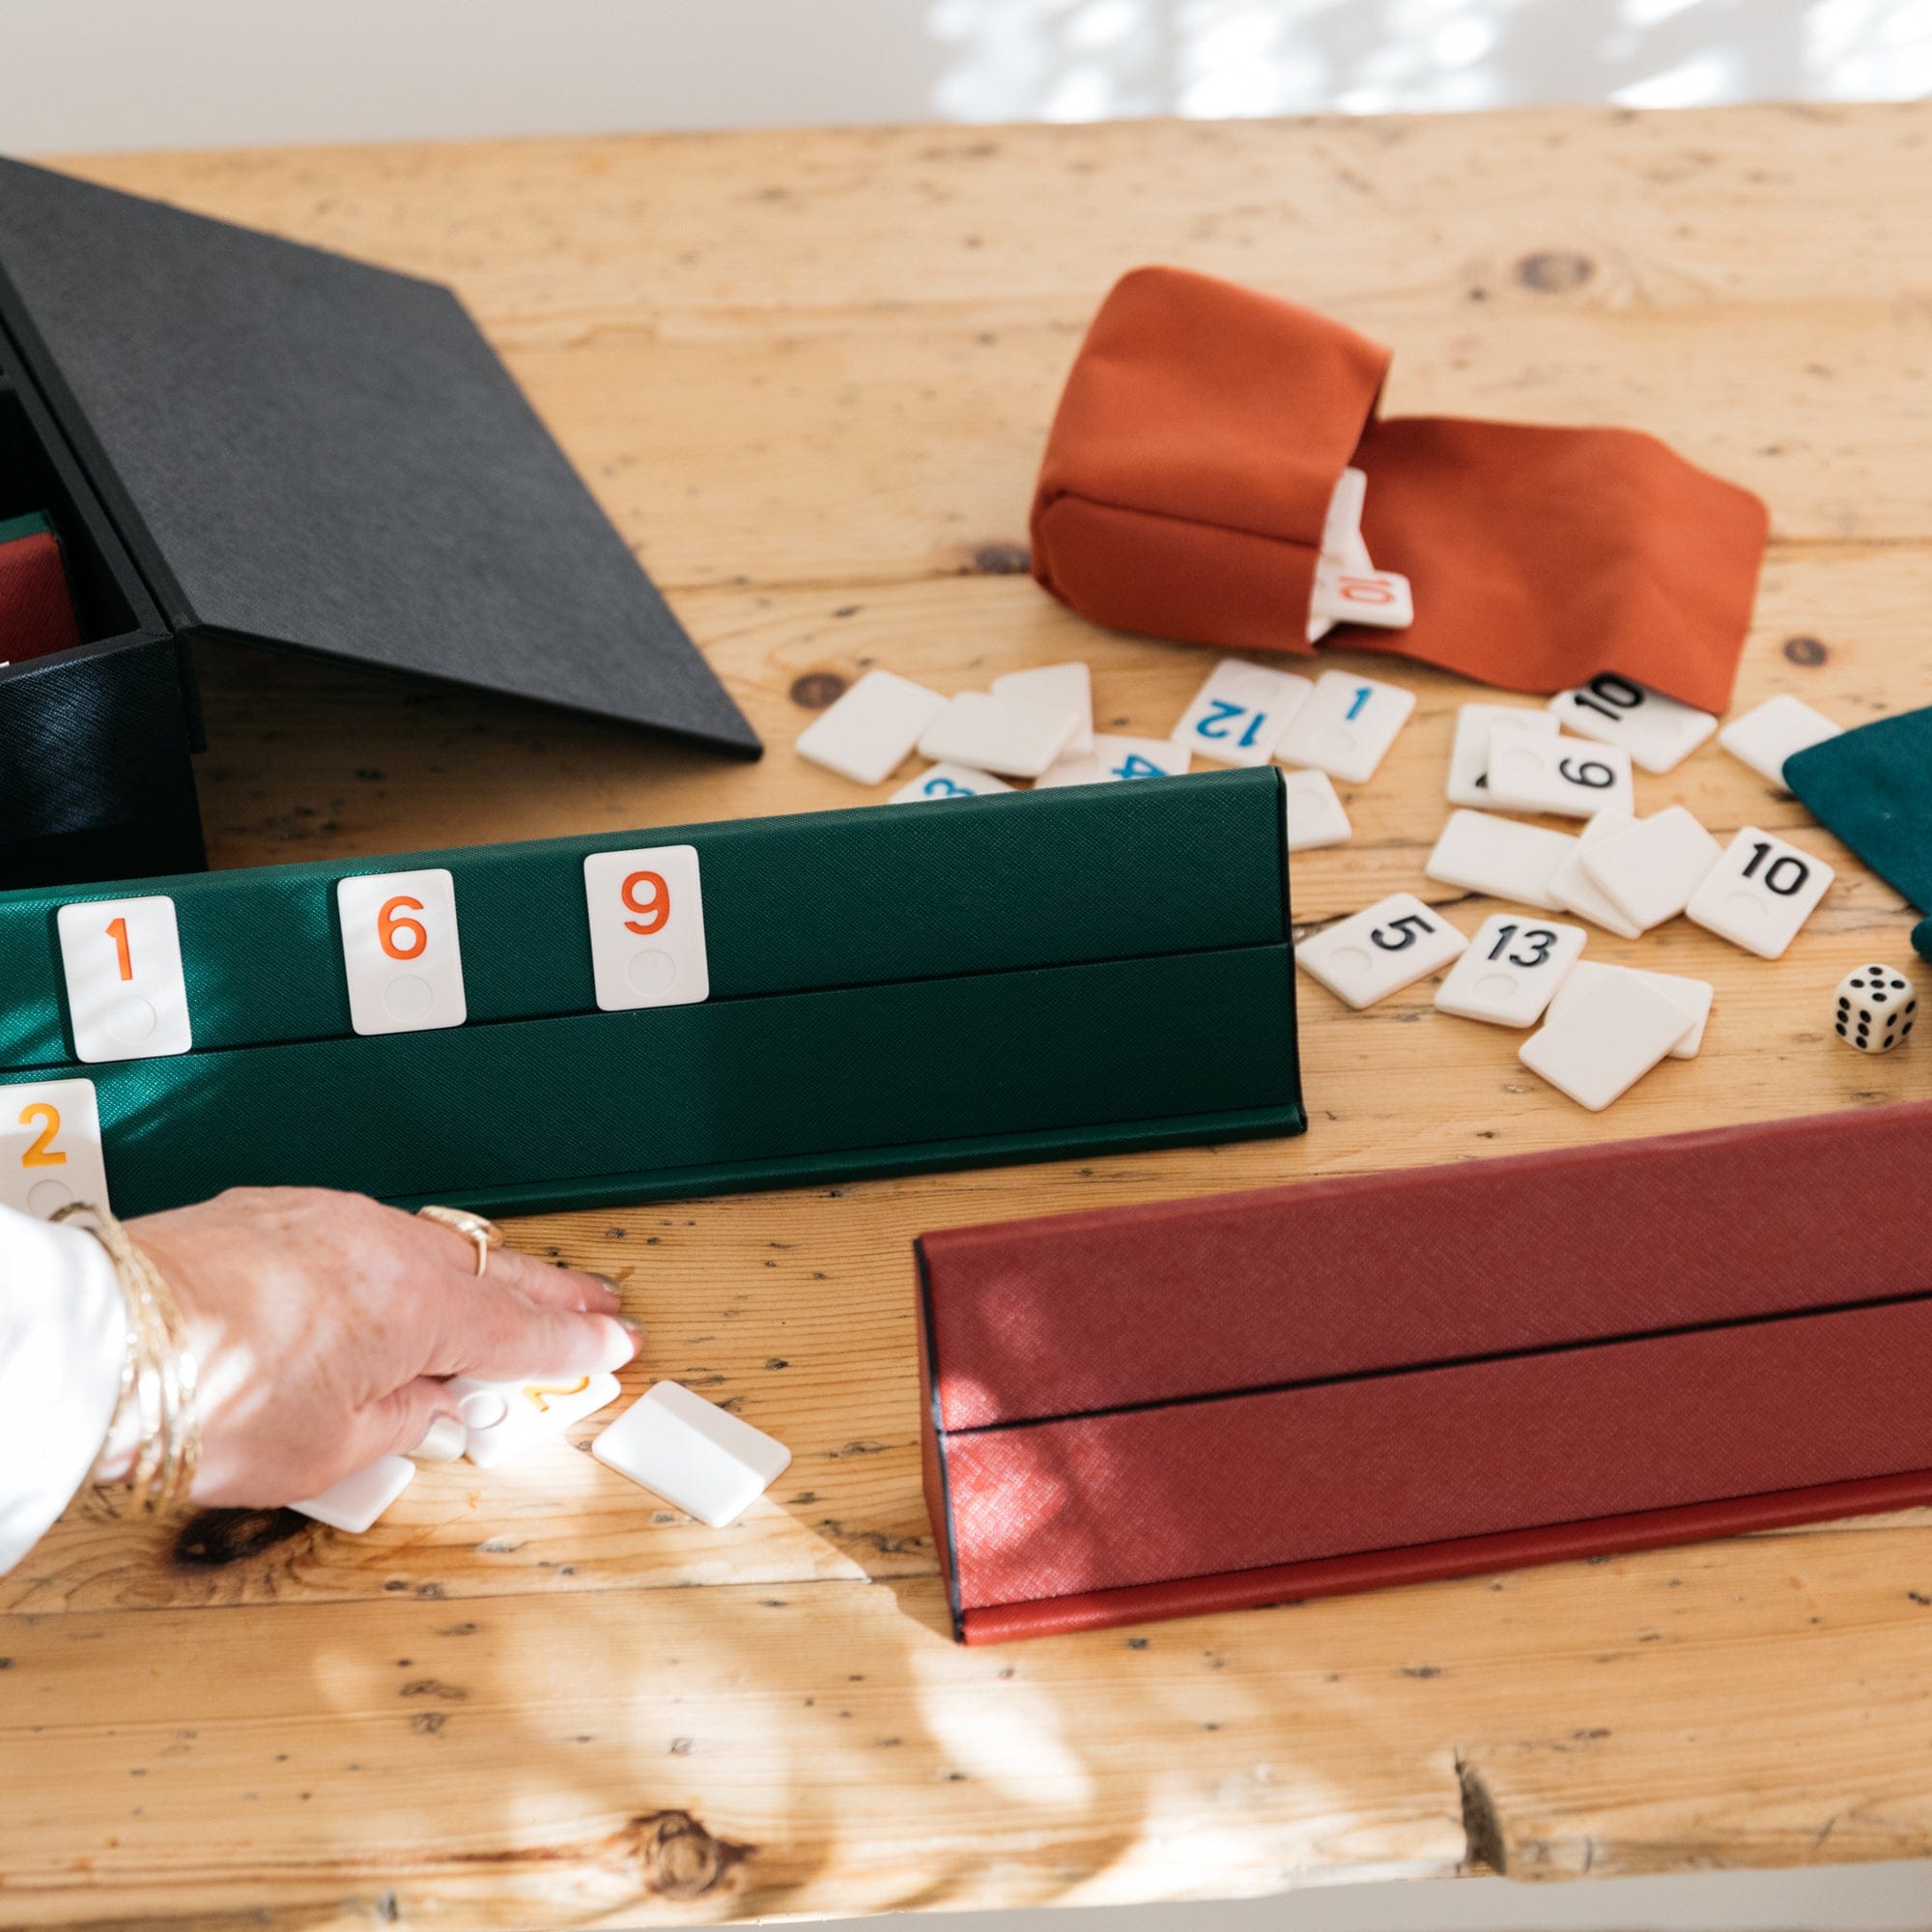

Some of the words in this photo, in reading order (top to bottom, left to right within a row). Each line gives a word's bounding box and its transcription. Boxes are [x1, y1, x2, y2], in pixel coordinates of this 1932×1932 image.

[1346, 687, 1372, 721] 1
[1573, 670, 1645, 723] 10
[1195, 699, 1265, 749] 12
[1111, 753, 1167, 780] 4
[1741, 841, 1810, 896] 10
[377, 895, 428, 960] 6
[620, 870, 671, 935] 9
[105, 918, 133, 981] 1
[1370, 915, 1435, 952] 5
[1487, 923, 1558, 967] 13
[18, 1102, 68, 1169] 2
